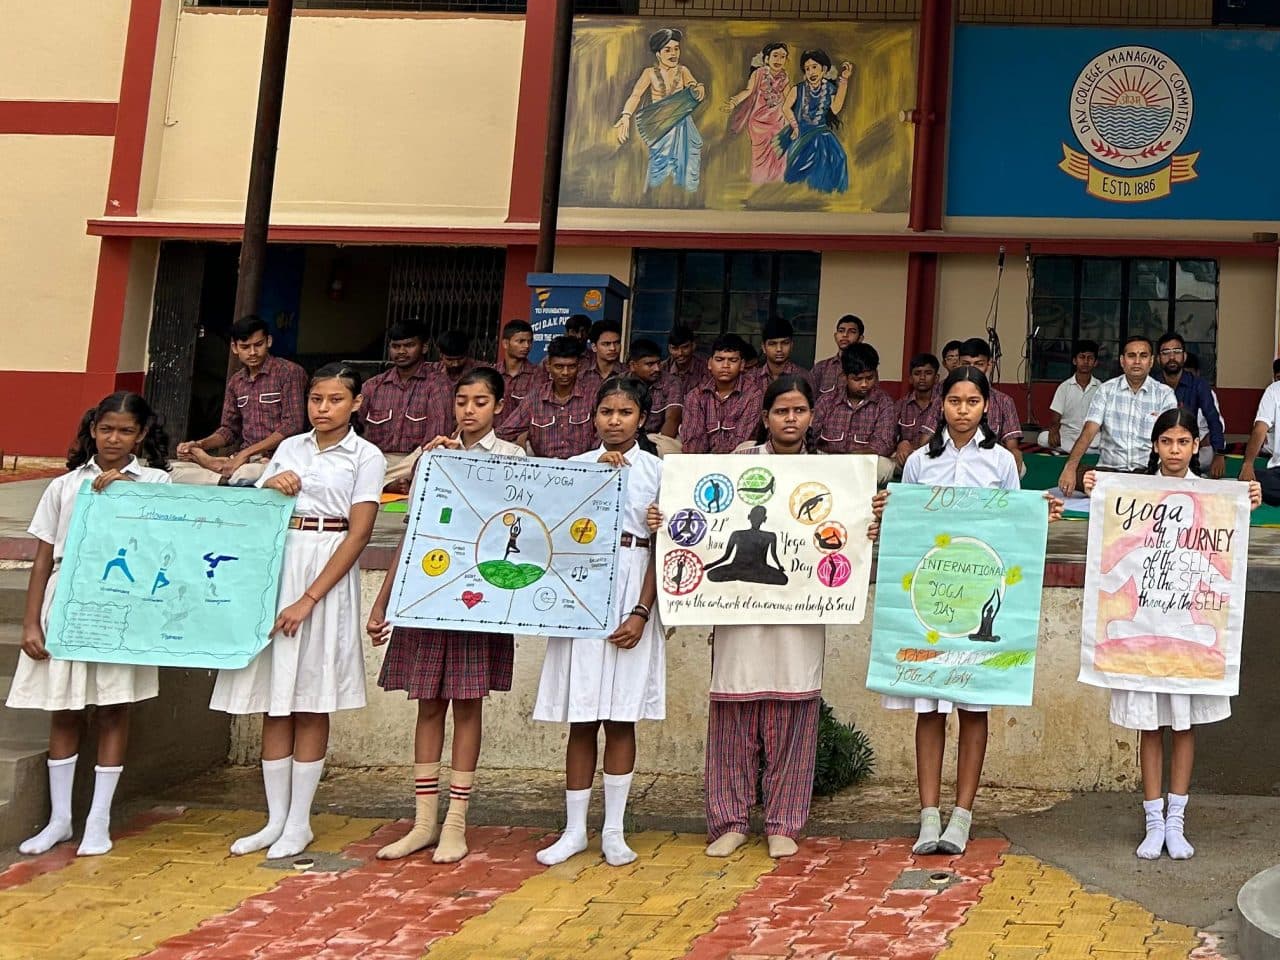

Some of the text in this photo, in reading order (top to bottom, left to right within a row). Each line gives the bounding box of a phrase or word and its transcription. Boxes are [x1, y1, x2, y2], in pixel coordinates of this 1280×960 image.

[1075, 50, 1189, 135] DAV COLLEGE MANAGING COMMITTEE
[1102, 177, 1156, 196] ESTD. 1886
[531, 321, 541, 332] TCI
[464, 464, 496, 482] TCI
[544, 474, 574, 488] YOGA
[504, 485, 533, 506] DAY
[781, 531, 806, 555] Yoga
[1144, 527, 1235, 553] is the JOURNEY
[790, 559, 813, 578] Day
[919, 558, 1006, 577] INTERNATIONAL
[1143, 549, 1217, 577] of the SELF
[929, 580, 964, 600] YOGA
[1142, 570, 1219, 591] to the SELF
[694, 593, 706, 608] the
[826, 597, 833, 611] &
[836, 596, 856, 611] Soul
[1176, 588, 1194, 611] the
[1195, 591, 1229, 611] SELF
